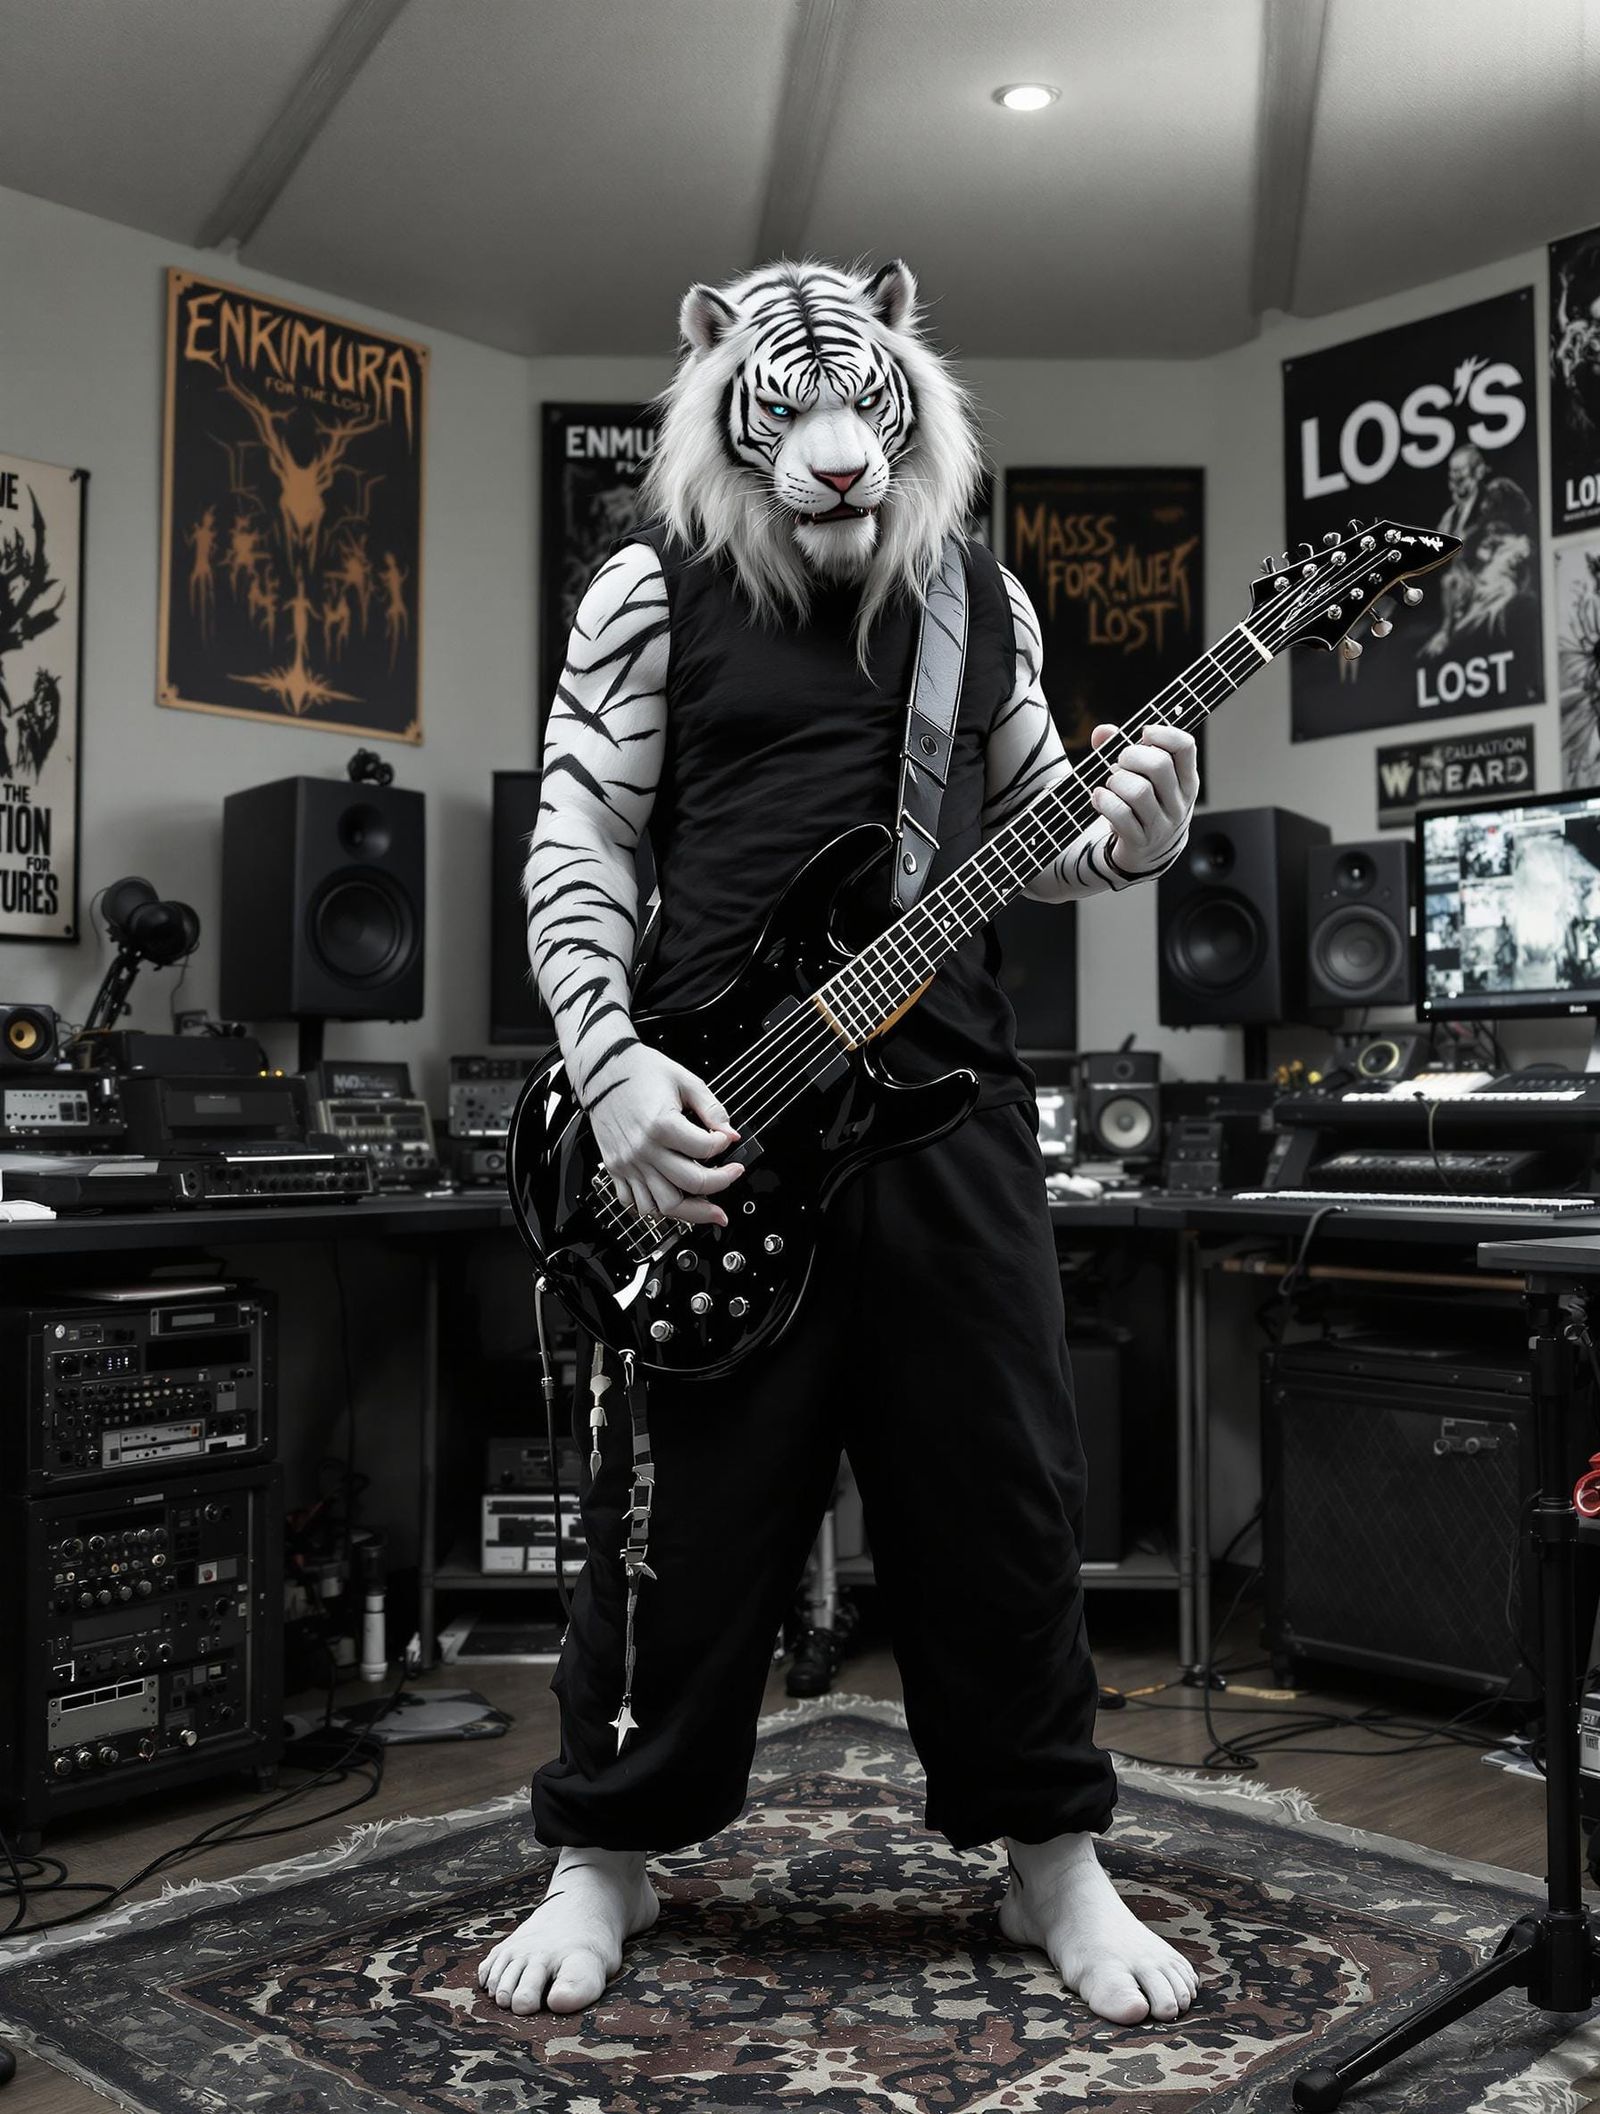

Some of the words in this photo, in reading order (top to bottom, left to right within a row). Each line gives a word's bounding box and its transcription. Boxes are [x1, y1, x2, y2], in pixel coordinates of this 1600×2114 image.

[185, 292, 413, 452] ENKIMURA
[265, 377, 296, 396] FOR
[302, 385, 326, 404] THE
[1048, 558, 1110, 620] FOR
[1416, 650, 1515, 708] LOST
[3, 783, 31, 804] THE
[26, 856, 51, 872] FOR
